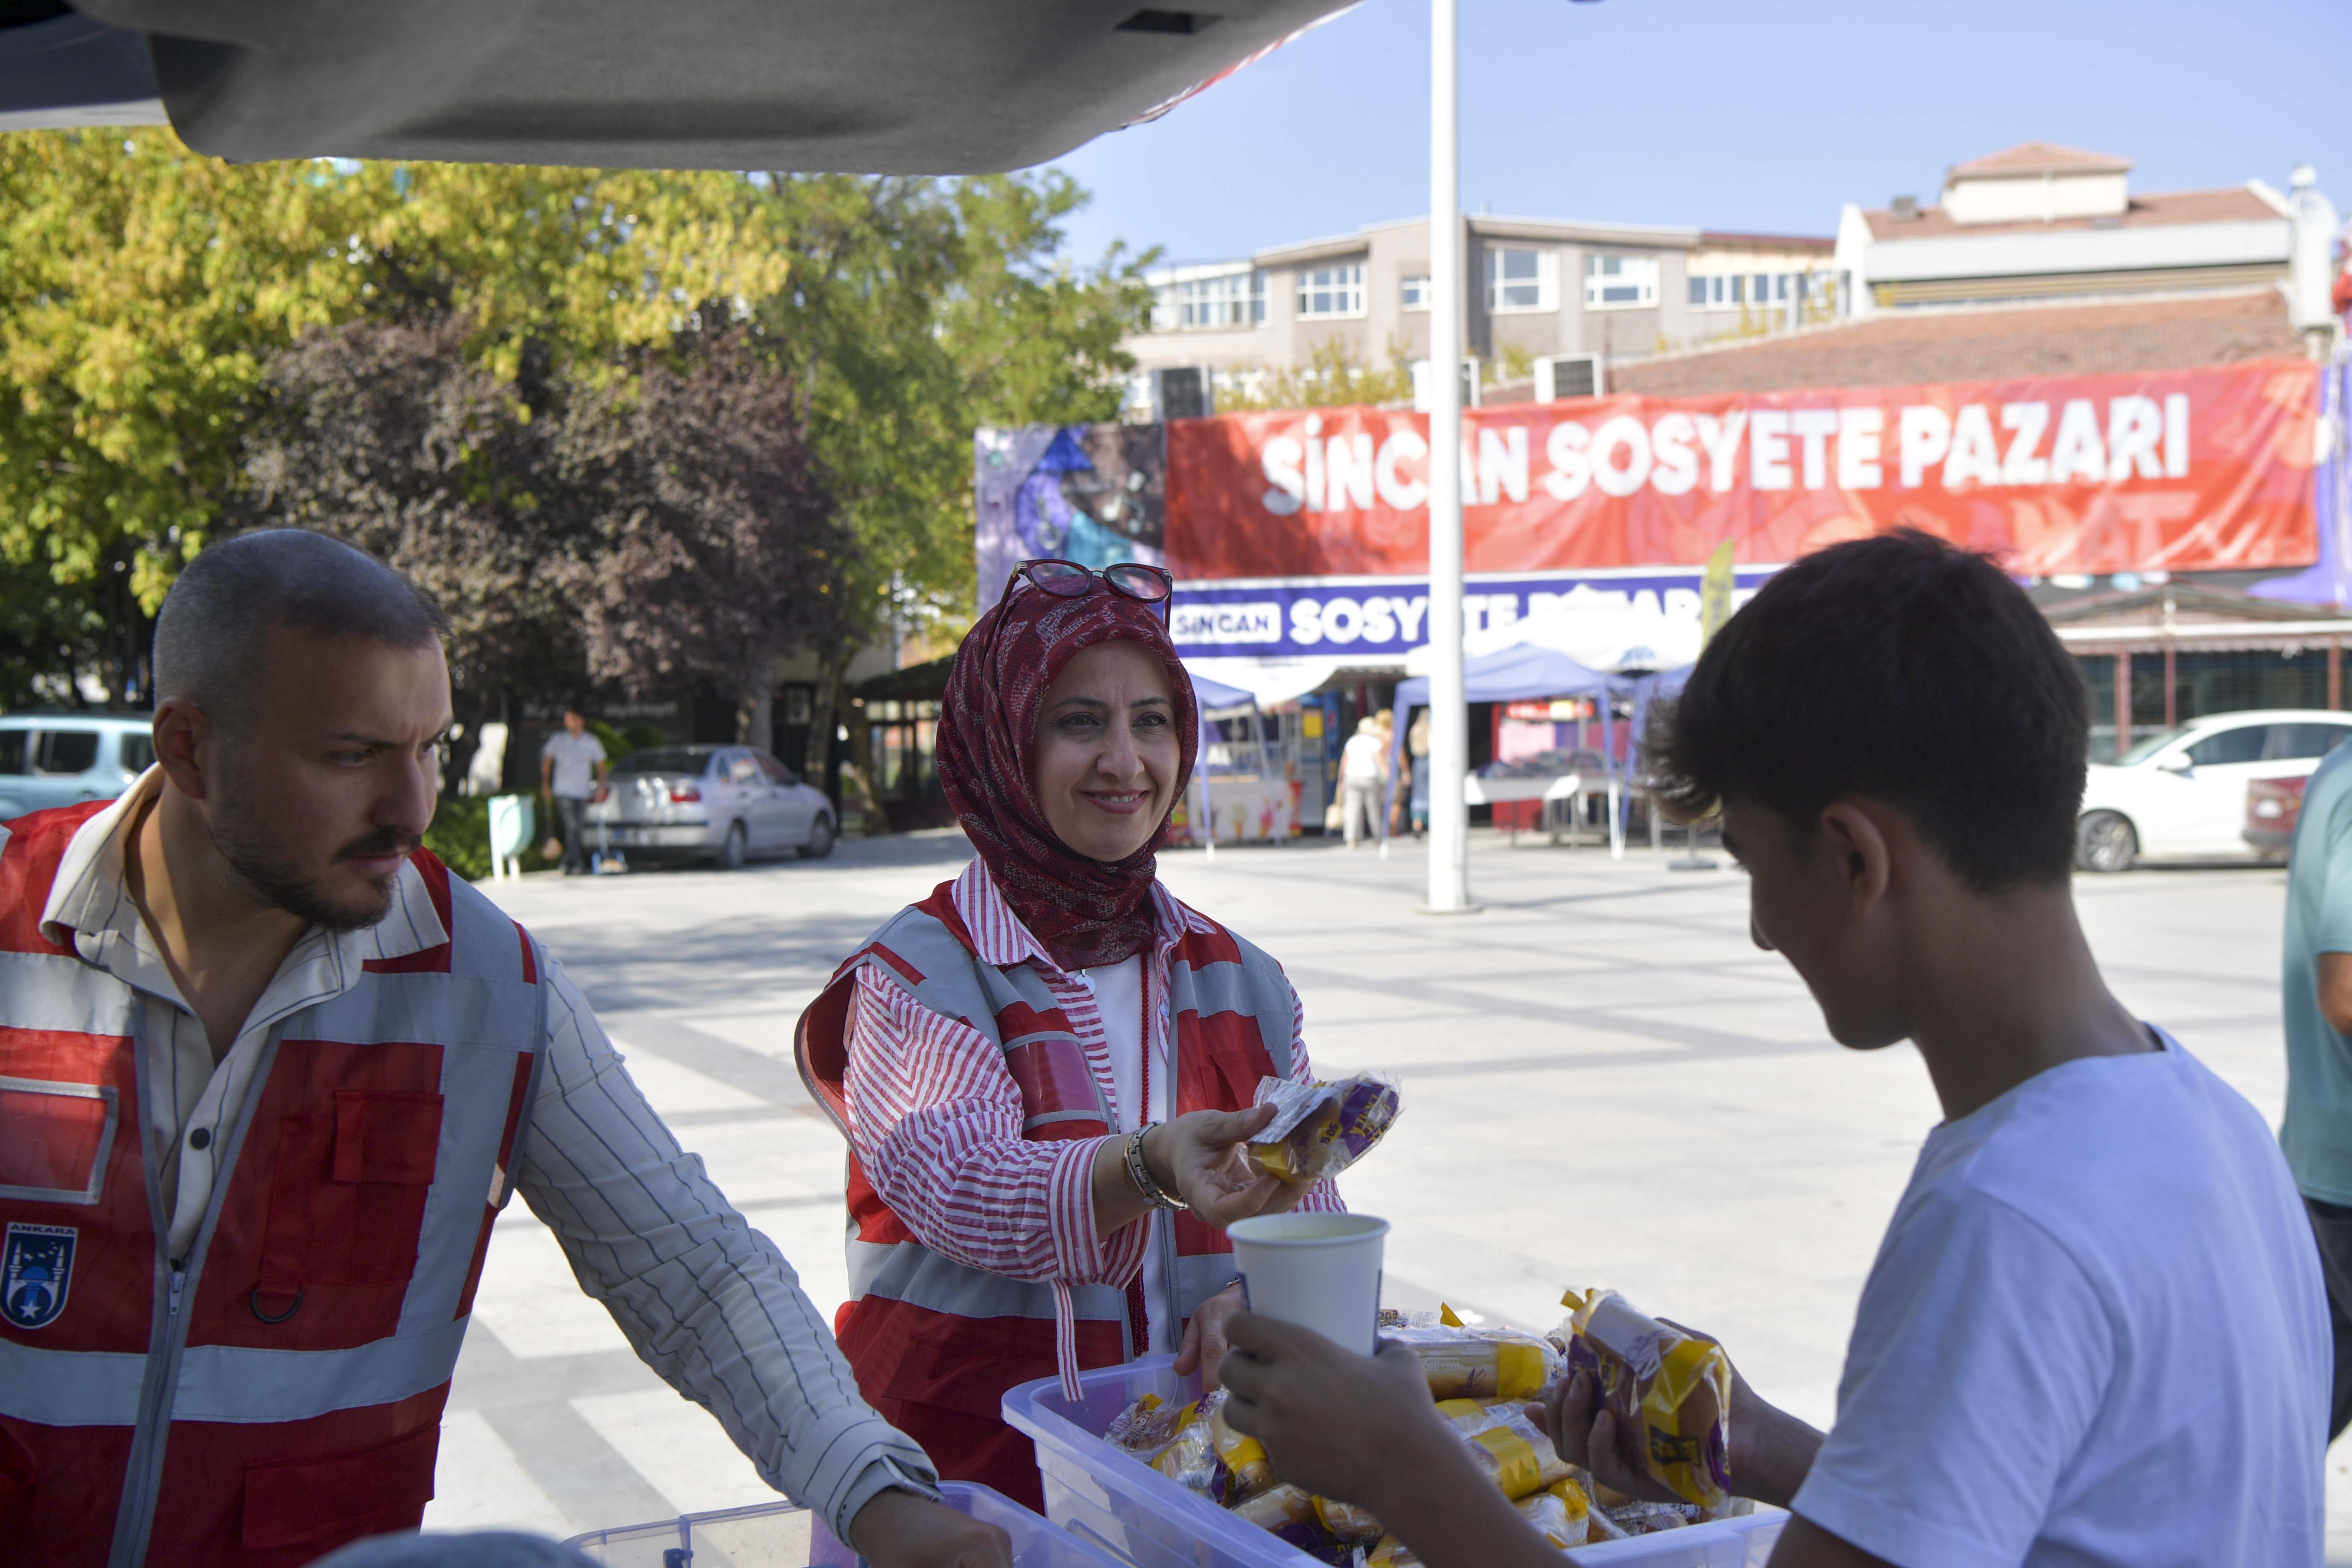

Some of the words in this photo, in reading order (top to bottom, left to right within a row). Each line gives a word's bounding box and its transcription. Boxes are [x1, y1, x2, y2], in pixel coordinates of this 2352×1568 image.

[1544, 407, 1882, 501] SOSYETE
[1900, 393, 2189, 488] PAZARI
[1289, 593, 1518, 644] SOSYTE
[11, 1224, 75, 1235] ANKARA
